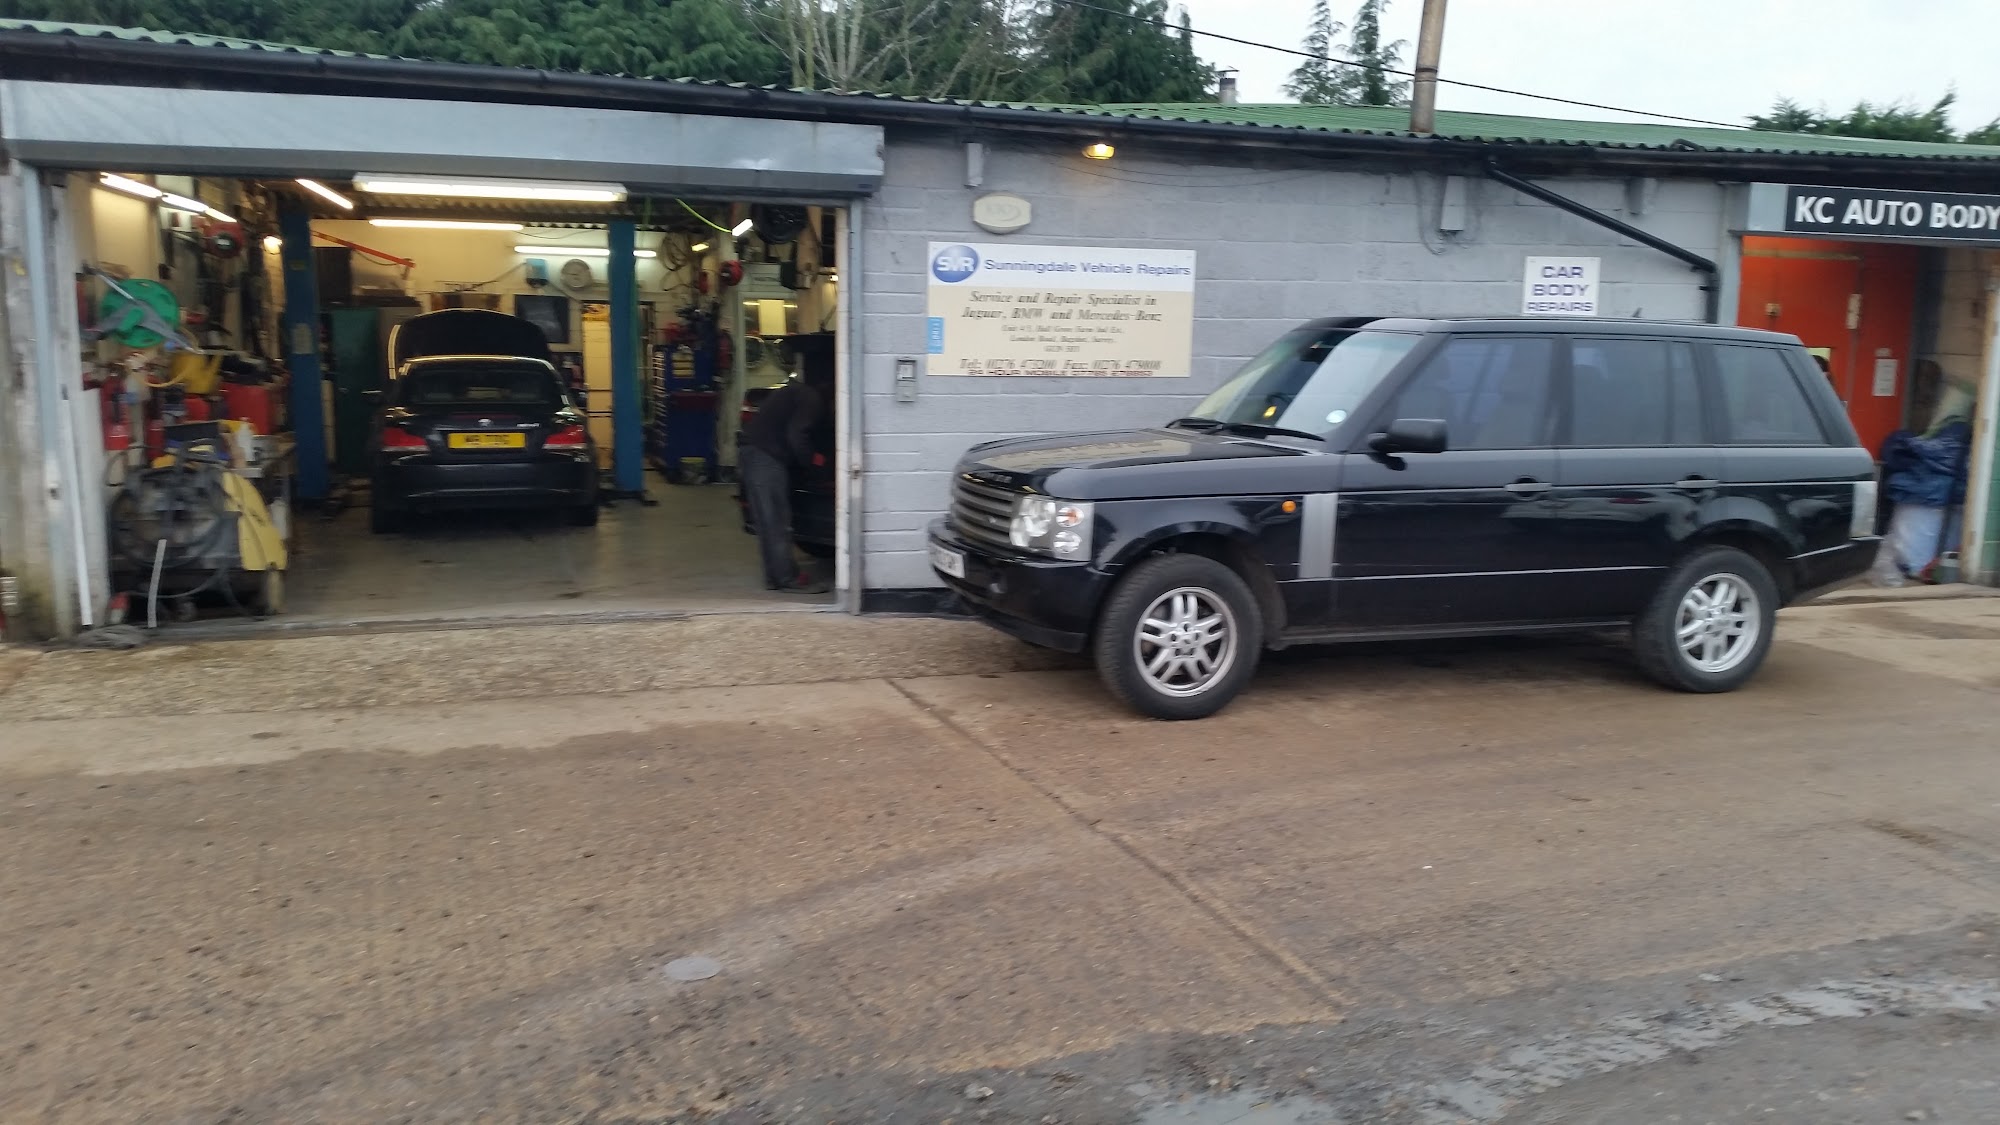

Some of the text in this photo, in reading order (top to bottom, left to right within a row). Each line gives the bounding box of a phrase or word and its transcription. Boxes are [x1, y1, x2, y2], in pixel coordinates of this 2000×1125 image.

[1795, 196, 2000, 230] KC AUTO BODY
[937, 256, 975, 272] SVR
[984, 259, 1191, 276] Sunningdale Vehicle Repairs
[1542, 266, 1583, 278] CAR
[1532, 284, 1589, 296] BODY
[969, 291, 1157, 307] Service and Repair Specialist in
[1011, 307, 1043, 319] BMW
[1050, 309, 1073, 319] and
[1528, 302, 1593, 311] REPAIRS
